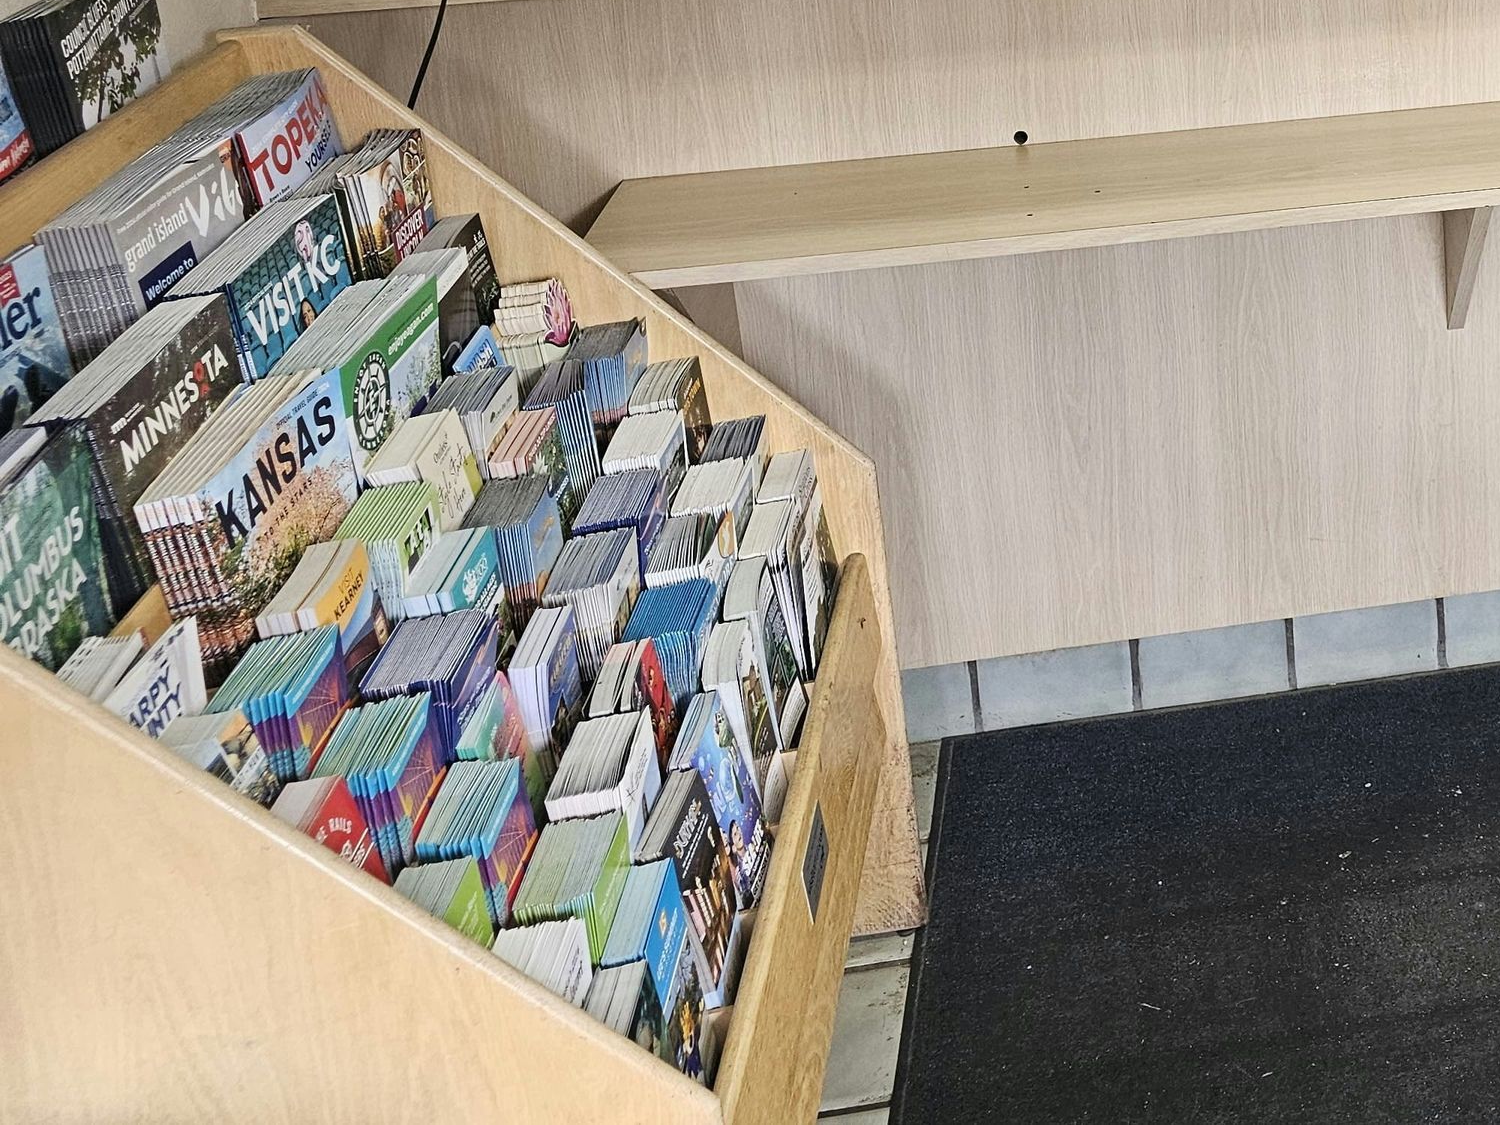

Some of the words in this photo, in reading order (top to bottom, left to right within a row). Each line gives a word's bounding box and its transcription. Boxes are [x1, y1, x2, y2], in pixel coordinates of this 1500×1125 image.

[249, 77, 327, 192] TOPEKA
[124, 232, 156, 272] grand
[156, 203, 188, 243] island
[395, 208, 424, 250] DISCOVER
[146, 266, 184, 301] Welcome
[246, 261, 306, 346] VISIT
[303, 234, 341, 293] KC
[119, 343, 229, 473] MINNESOTA
[214, 395, 336, 550] KANSAS
[290, 478, 313, 507] STARS
[333, 573, 365, 621] KEARNEY
